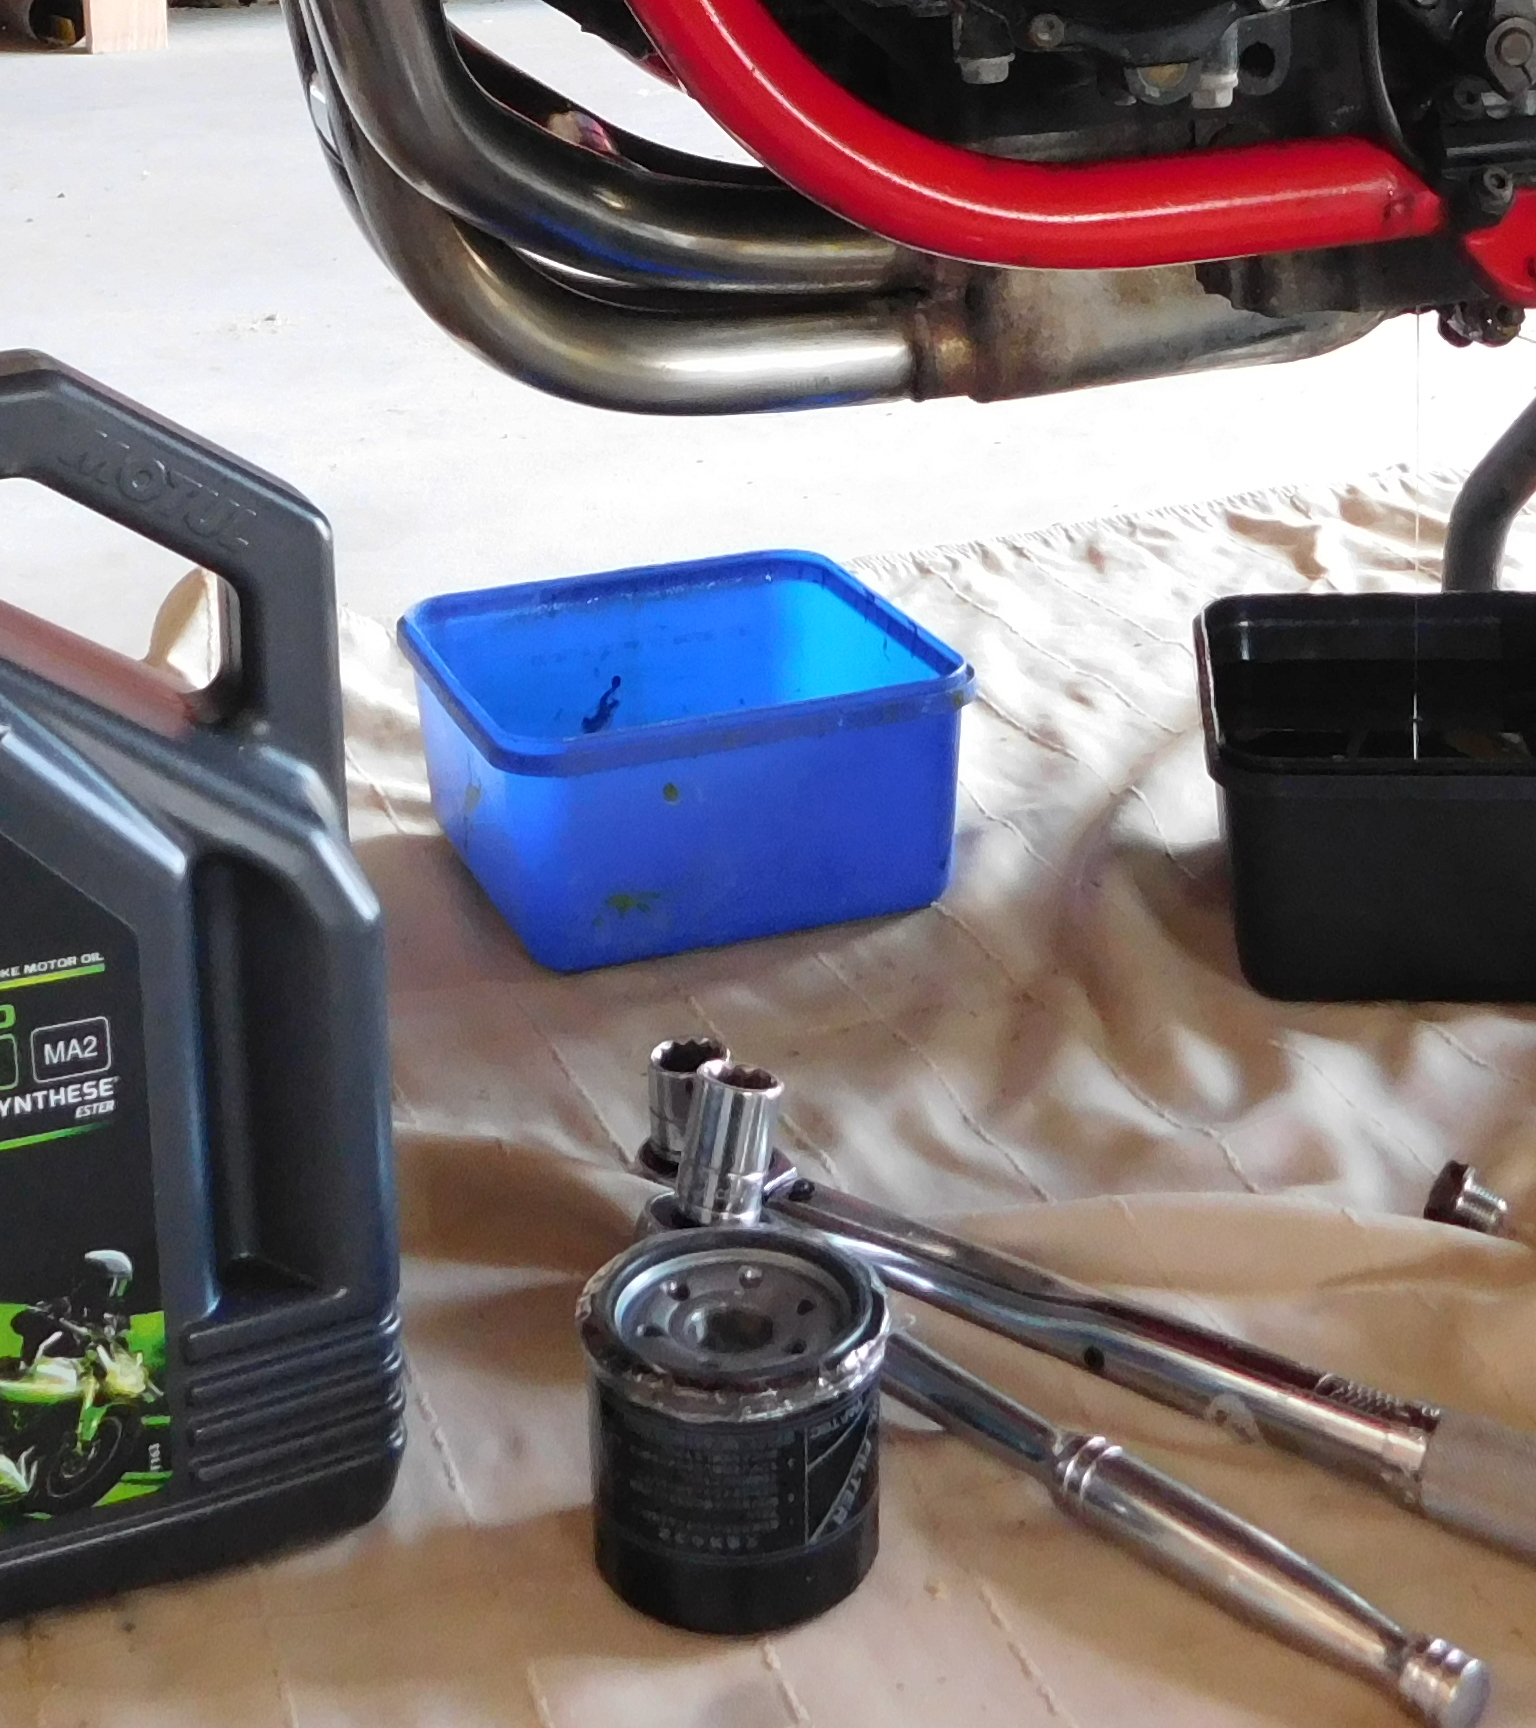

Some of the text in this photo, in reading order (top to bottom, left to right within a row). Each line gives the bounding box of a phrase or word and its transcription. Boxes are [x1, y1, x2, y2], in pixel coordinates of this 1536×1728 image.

[22, 956, 77, 975] MOTOR
[79, 951, 105, 964] OIL
[43, 1035, 98, 1067] MA2
[74, 1098, 116, 1120] ESTER
